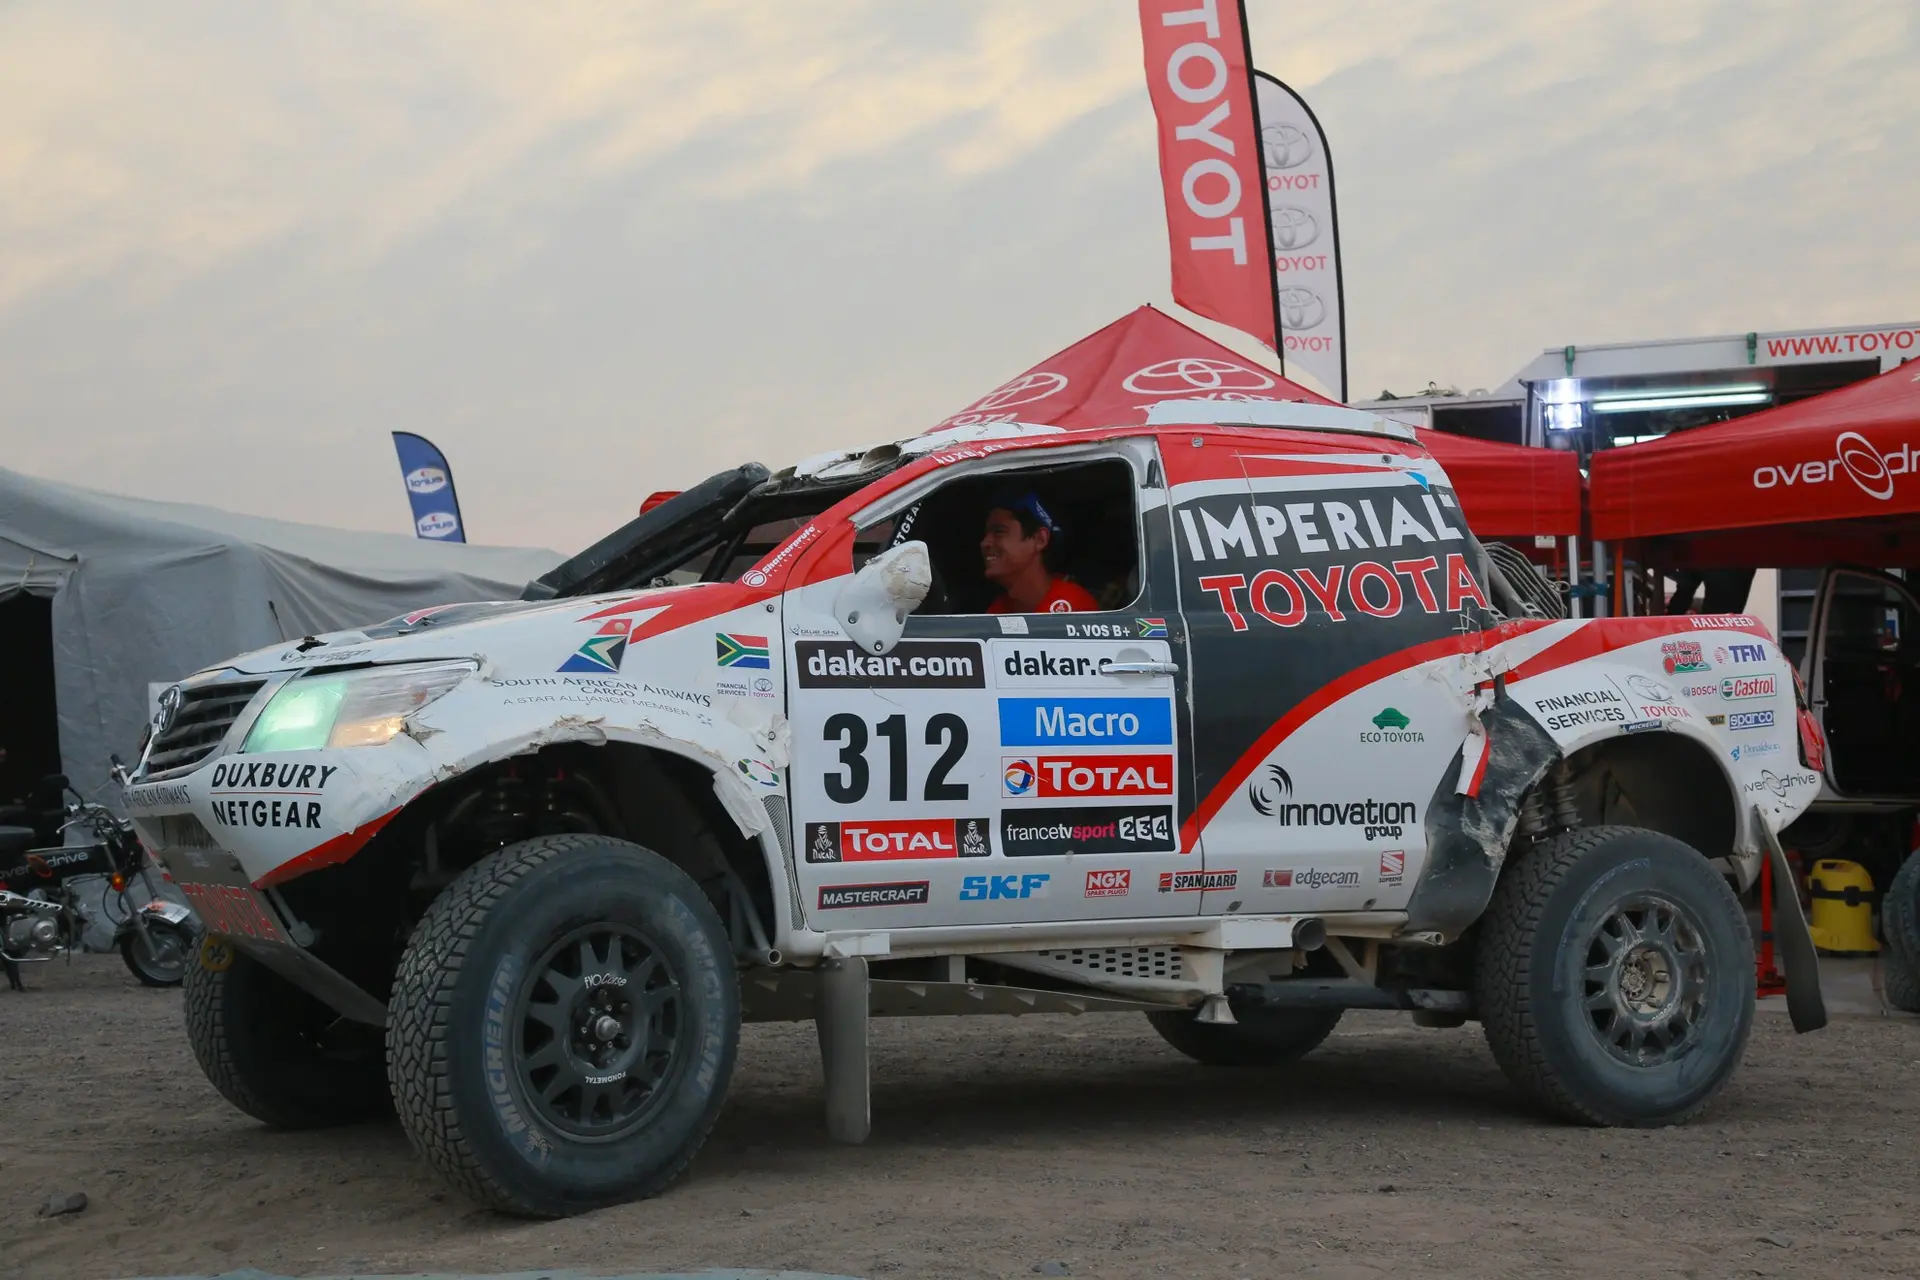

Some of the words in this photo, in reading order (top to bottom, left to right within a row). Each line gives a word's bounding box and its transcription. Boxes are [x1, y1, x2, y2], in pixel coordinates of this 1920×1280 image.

[1753, 459, 1840, 490] over
[1178, 493, 1464, 562] IMPERIAL
[1200, 552, 1489, 632] TOYOTA
[1066, 624, 1080, 637] D.
[1082, 624, 1109, 637] VOS
[1113, 625, 1130, 637] B+
[1689, 616, 1756, 628] HALLSPEED
[808, 649, 973, 677] dakar.com
[1674, 651, 1703, 664] World
[1728, 644, 1766, 663] TFM
[1004, 650, 1113, 677] dakar.c
[491, 678, 556, 688] SOUTH
[562, 677, 637, 691] AFRICAN
[643, 684, 711, 707] AIRWAYS
[581, 686, 635, 697] CARGO
[1691, 685, 1717, 696] BOSCH
[1734, 677, 1774, 696] Castrol
[559, 695, 630, 705] ALLIANCE
[632, 699, 690, 717] MEMBER
[1535, 690, 1622, 714] FINANCIAL
[1035, 706, 1139, 738] Macro
[1547, 708, 1626, 731] SERVICES
[1640, 705, 1692, 720] TOYOTA
[1729, 711, 1773, 726] sparco
[1628, 720, 1661, 731] MICHELIN
[1360, 733, 1380, 743] ECO
[1383, 732, 1425, 743] TOYOTA
[1744, 741, 1781, 754] Donaldson
[822, 713, 970, 804] 312
[211, 763, 338, 789] DUXBURY
[1043, 761, 1168, 791] TOTAL
[1780, 773, 1816, 788] drive
[211, 801, 322, 830] NETGEAR
[1280, 798, 1416, 827] innovation
[844, 828, 952, 853] TOTAL
[1364, 824, 1402, 841] group
[47, 851, 89, 868] drive
[959, 873, 1051, 901] SKF
[1088, 871, 1128, 889] NGK
[1295, 867, 1358, 891] edgecam
[823, 887, 924, 905] MASTERCRAFT
[1087, 889, 1106, 897] SPARK
[585, 1071, 627, 1084] FONDMETAL
